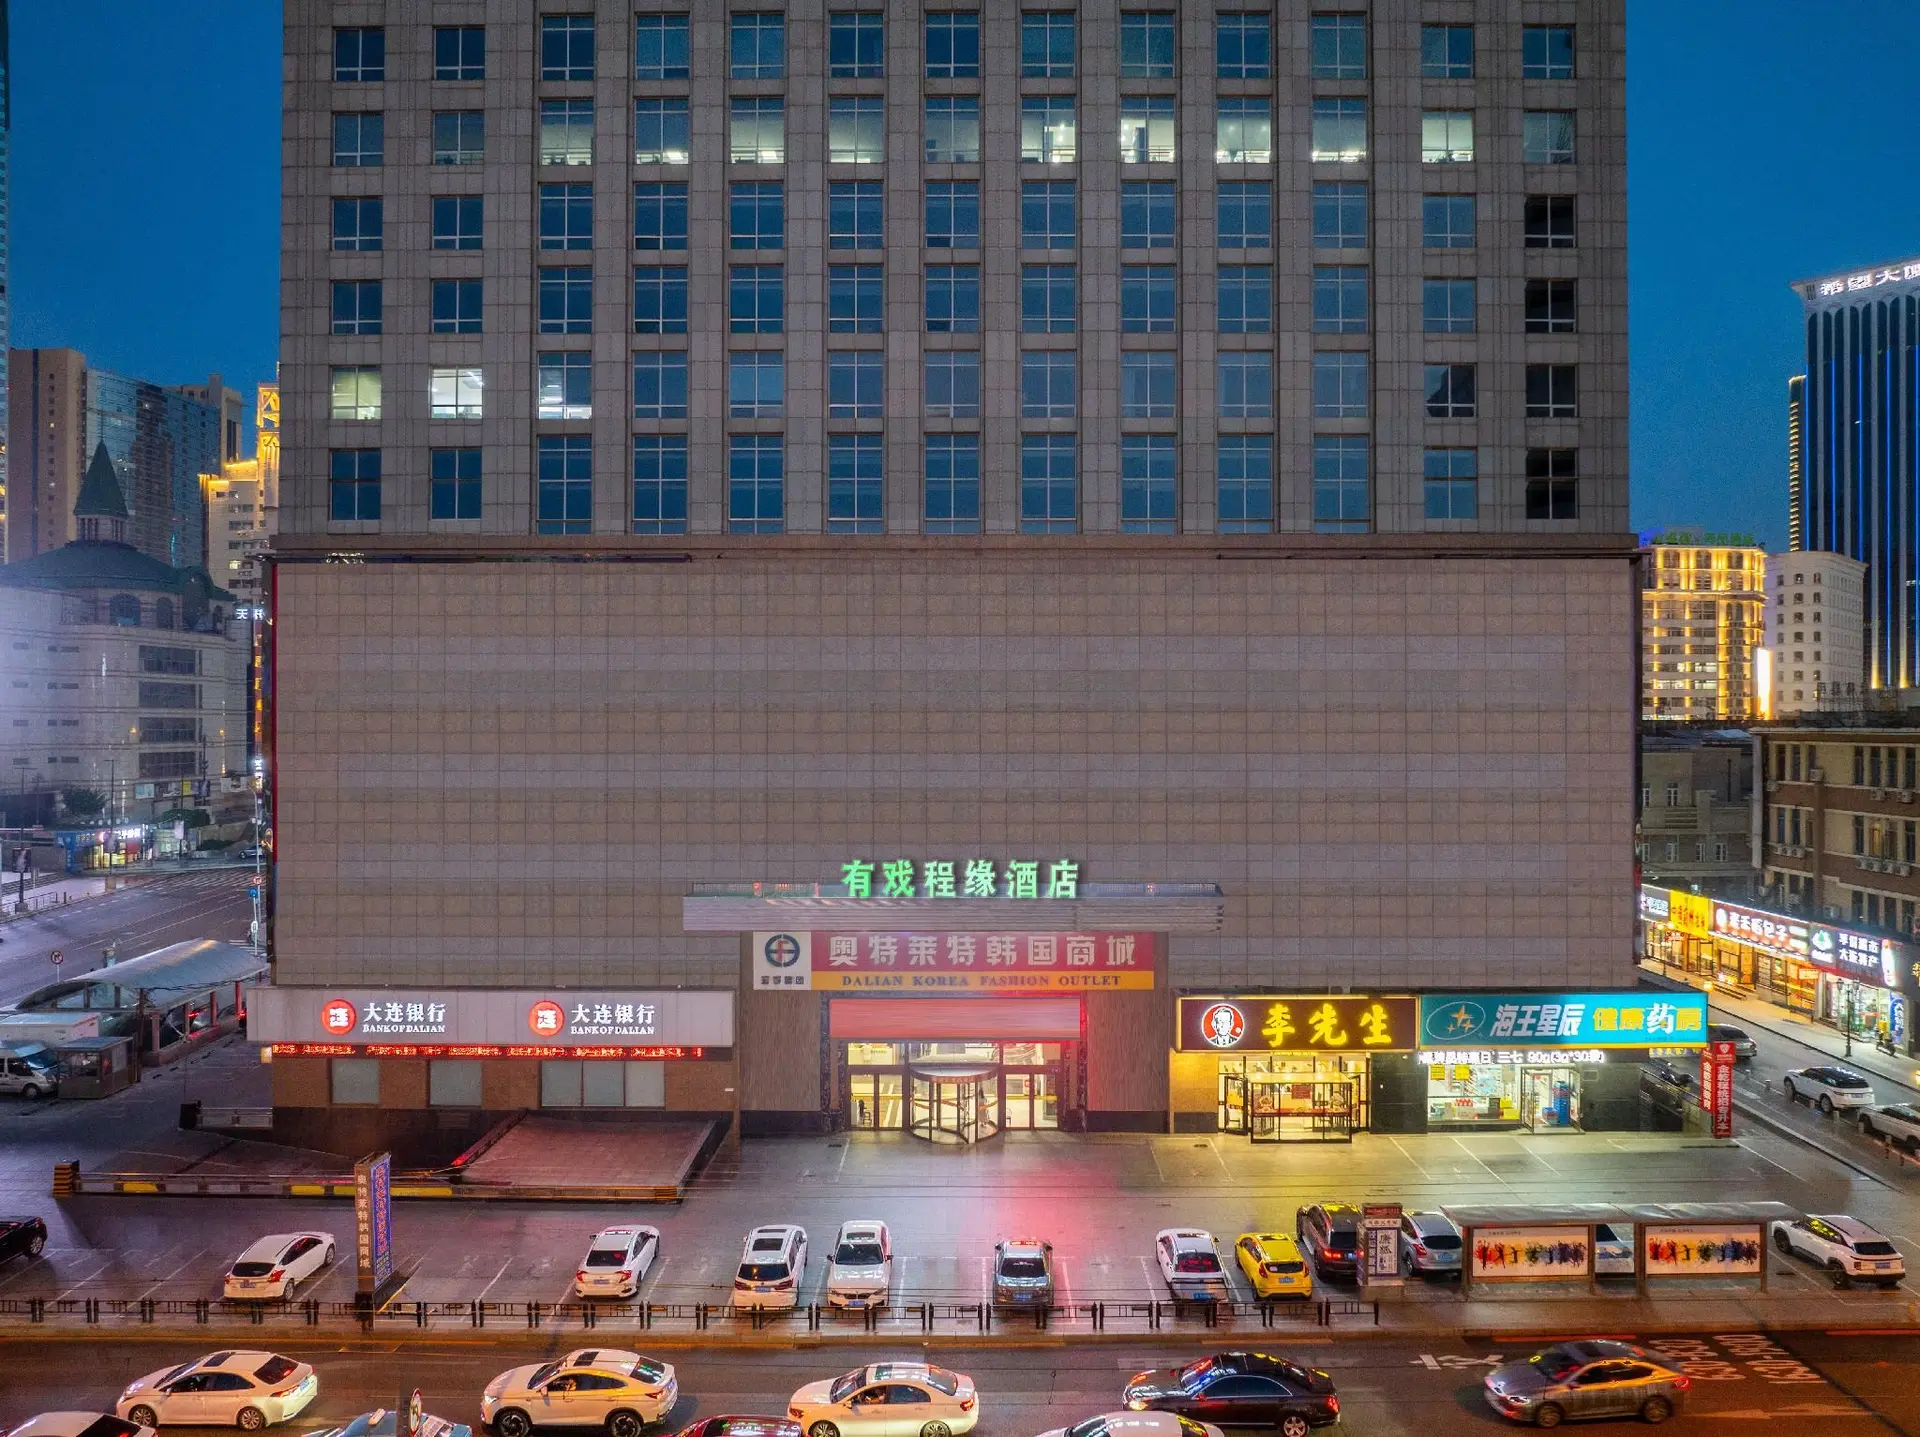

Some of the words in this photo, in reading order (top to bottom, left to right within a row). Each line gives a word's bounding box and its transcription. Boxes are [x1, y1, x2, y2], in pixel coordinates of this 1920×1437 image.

[841, 859, 1079, 898] 有戏程缘酒店
[829, 935, 1135, 966] 奥特莱特韩国商城
[843, 975, 903, 986] DALIAN
[912, 975, 969, 986] KOREA
[979, 975, 1050, 986] FASHION
[1059, 975, 1121, 986] OUTLET
[363, 1002, 446, 1023] 大连银行
[571, 1004, 655, 1025] 大连银行
[1261, 1003, 1394, 1048] 李先生
[1490, 1003, 1585, 1037] 海王星辰
[1593, 1003, 1702, 1035] 健康药房
[357, 1174, 371, 1268] 奥特莱特韩国商城
